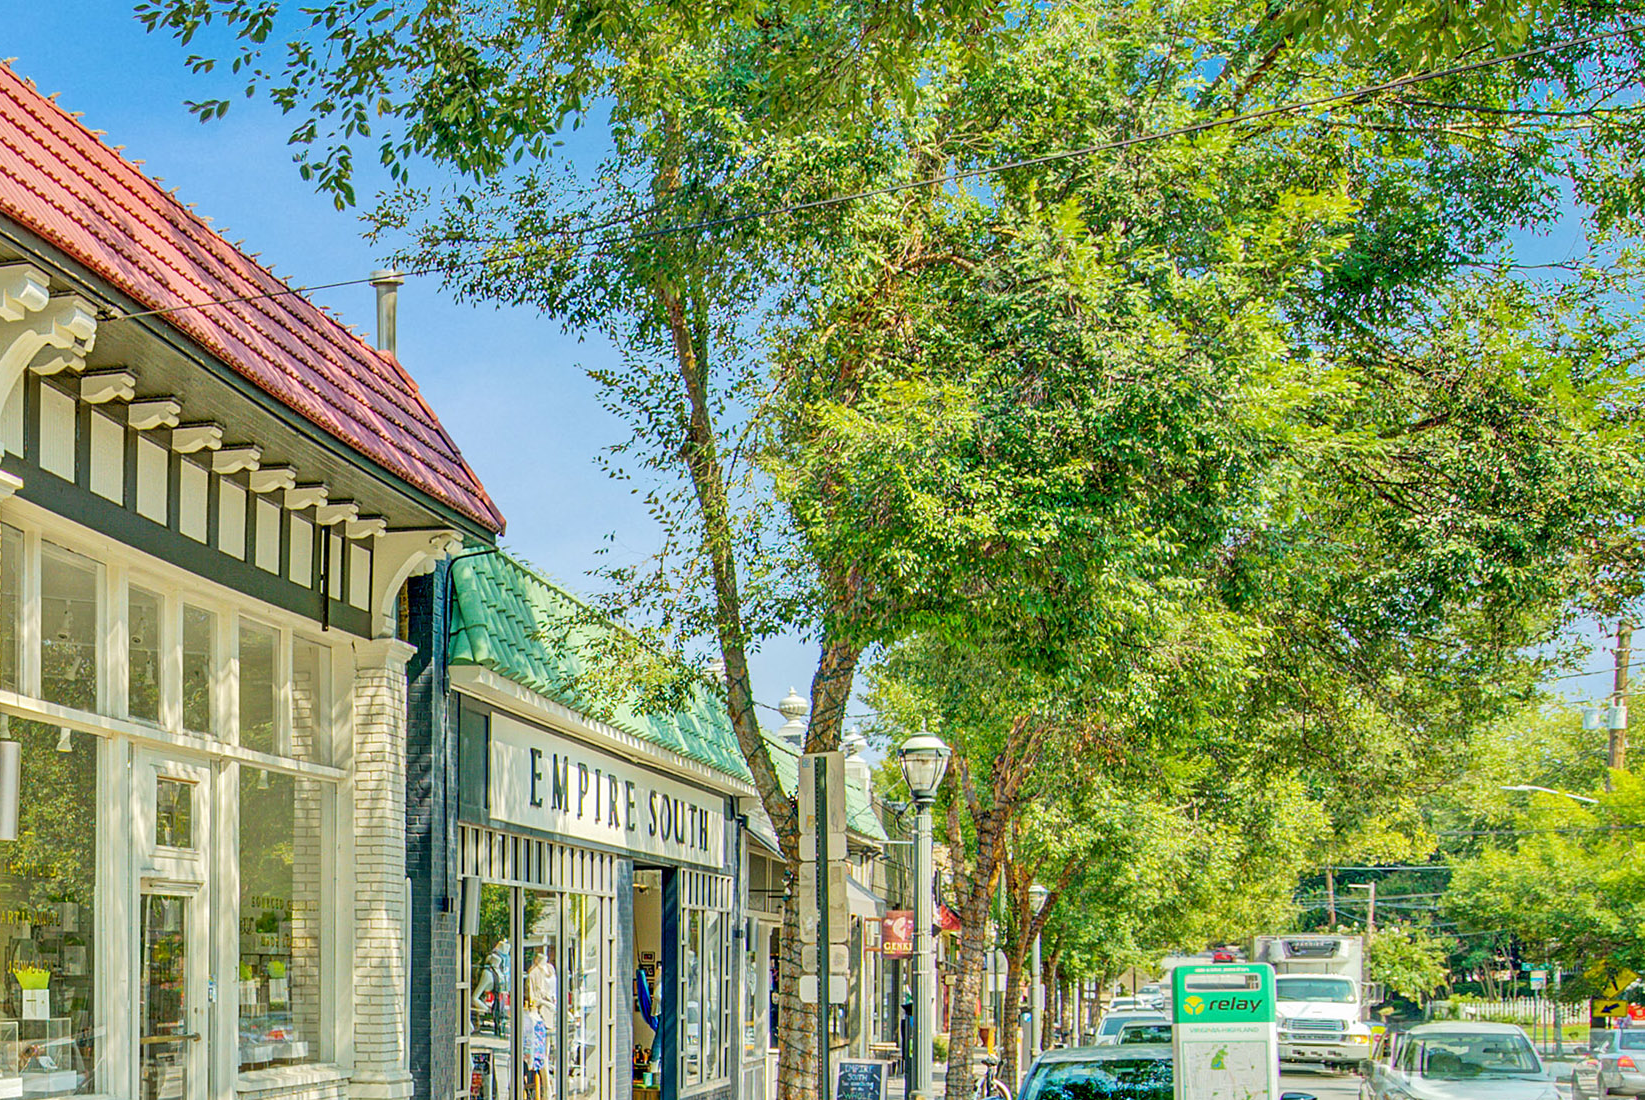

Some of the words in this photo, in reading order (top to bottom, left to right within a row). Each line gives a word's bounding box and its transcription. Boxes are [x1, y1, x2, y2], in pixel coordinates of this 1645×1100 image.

[529, 747, 635, 832] EMPIRE
[649, 789, 708, 852] SOUTH
[883, 942, 913, 951] GENKI
[1209, 996, 1263, 1013] relay
